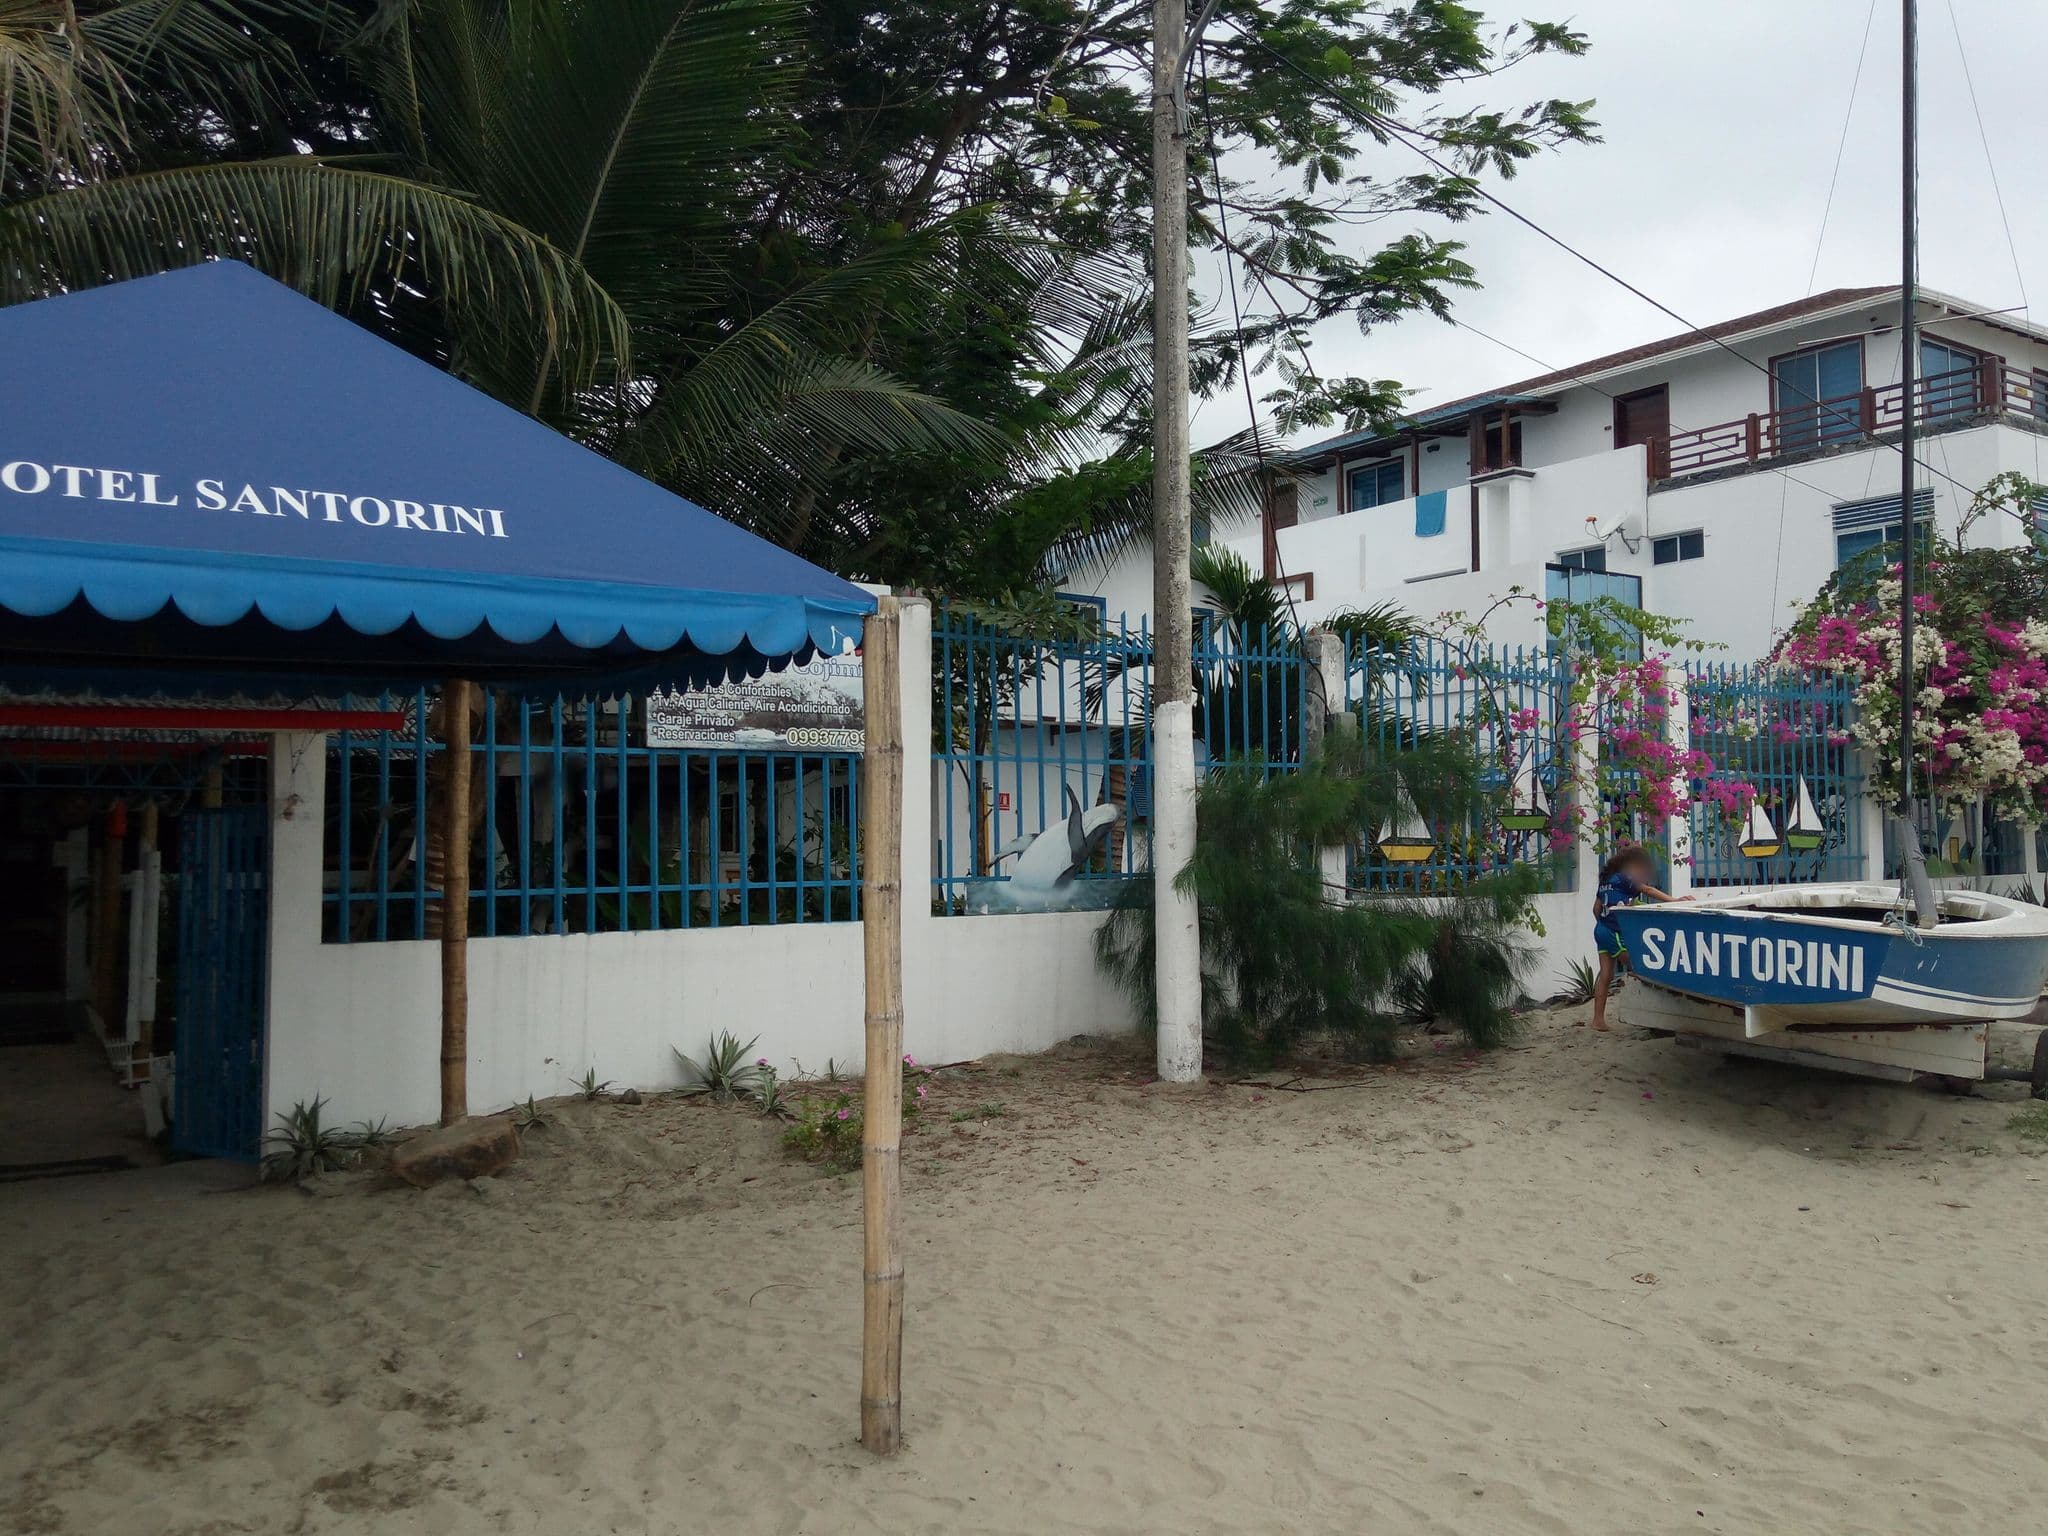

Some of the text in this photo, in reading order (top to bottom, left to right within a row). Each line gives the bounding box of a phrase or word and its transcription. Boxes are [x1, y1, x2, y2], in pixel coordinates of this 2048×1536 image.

[195, 479, 510, 538] SANTORINI
[727, 683, 792, 698] Confortables
[678, 699, 706, 713] Agua
[708, 700, 753, 713] Caliente,
[755, 701, 776, 712] Aire
[777, 701, 851, 715] Acondicionado
[694, 713, 735, 726] Privado
[1642, 927, 1864, 993] SANTORINI
